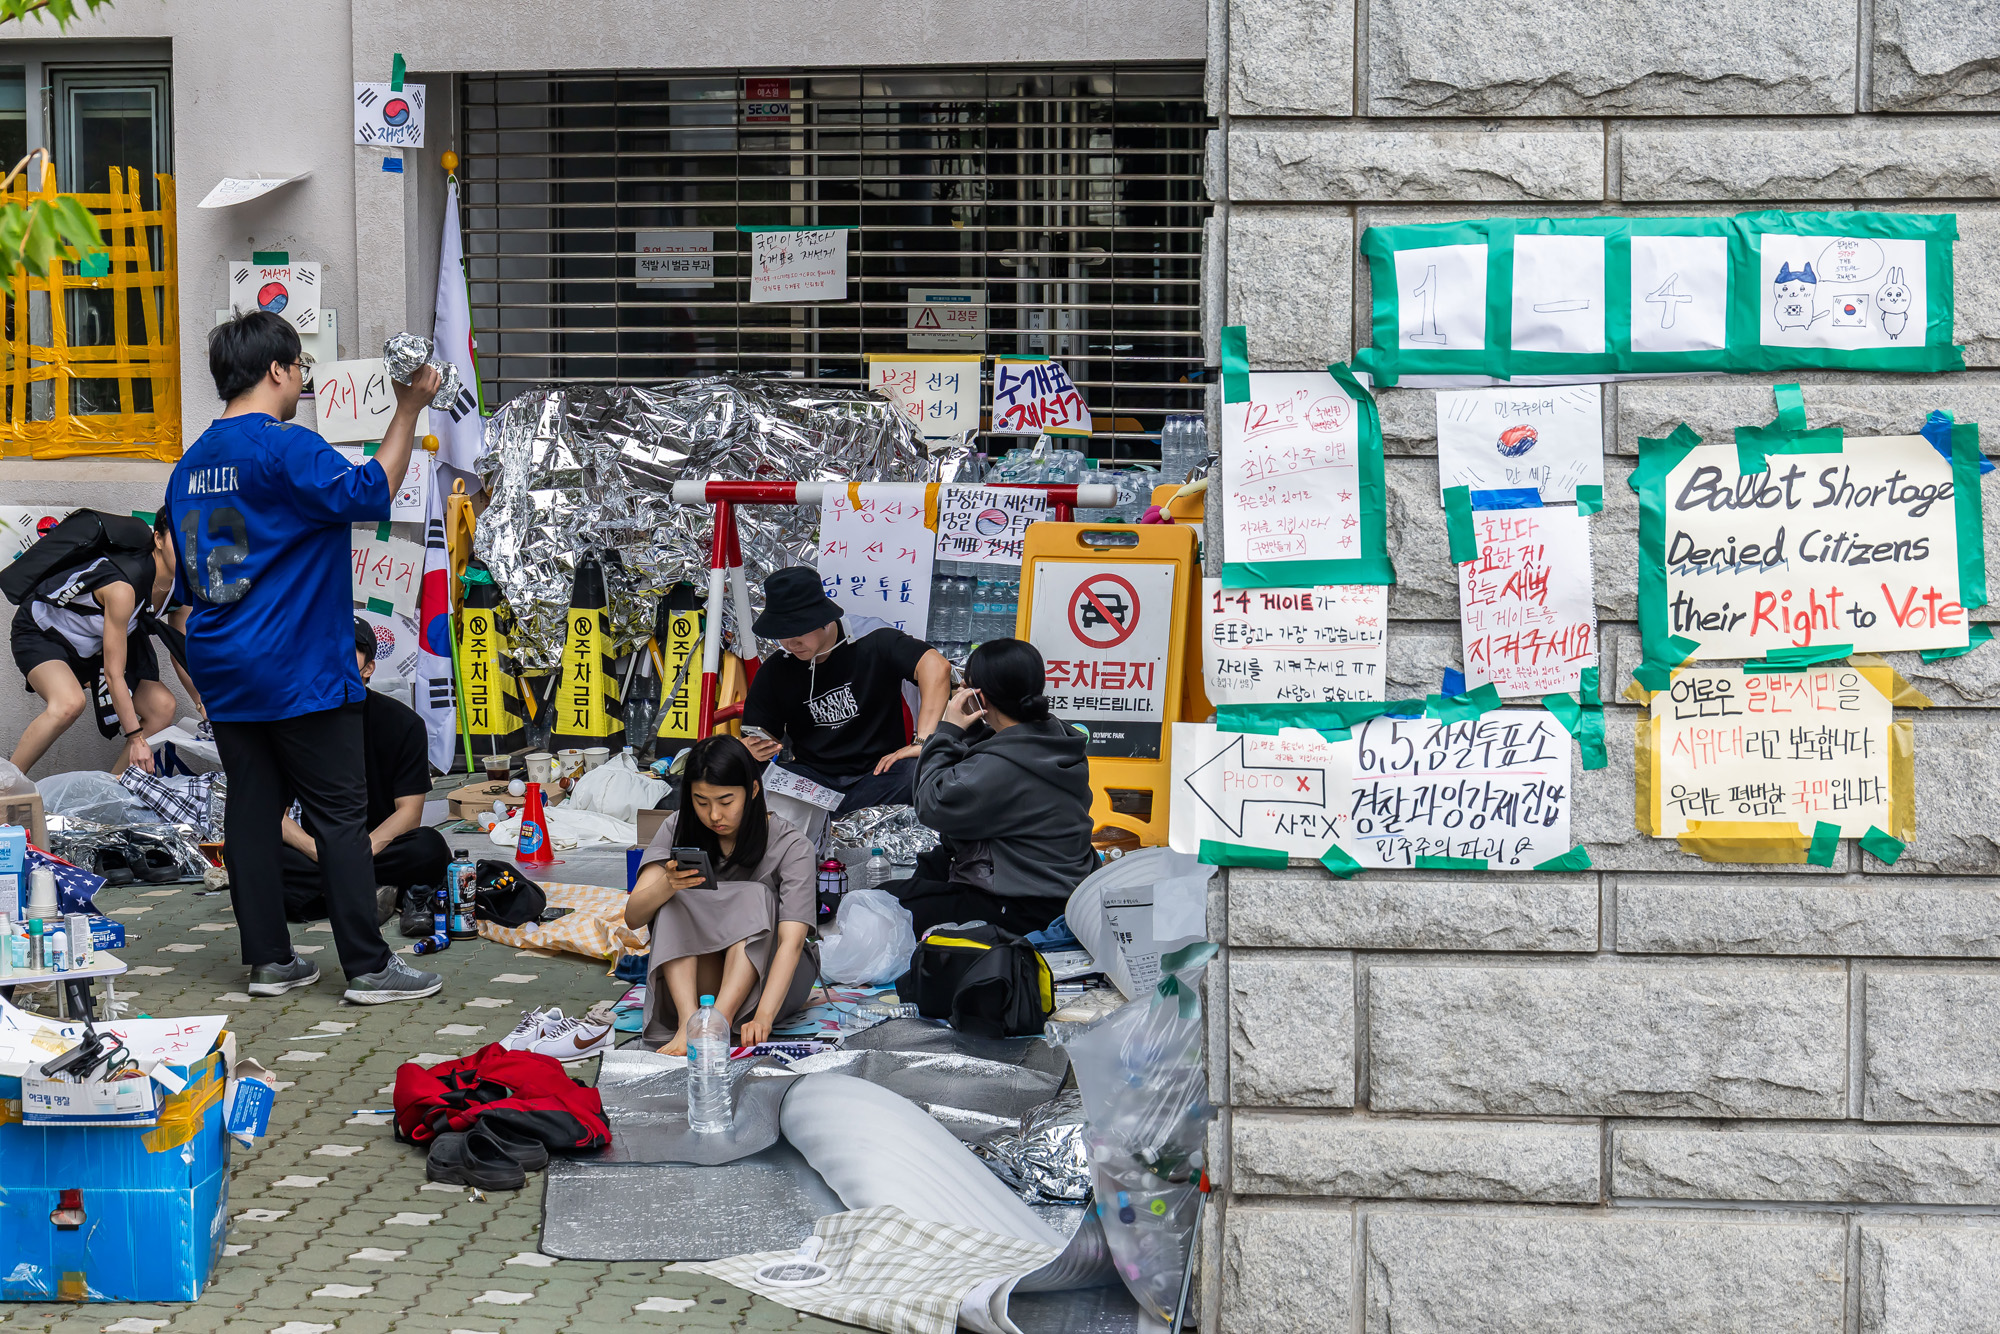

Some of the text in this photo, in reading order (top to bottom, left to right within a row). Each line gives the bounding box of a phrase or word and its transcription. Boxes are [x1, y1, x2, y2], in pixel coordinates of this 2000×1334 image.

[748, 103, 789, 115] SECOM
[260, 268, 291, 282] 재선거
[641, 260, 711, 271] 적발 시 벌금 부과
[947, 310, 978, 322] 고정문
[1409, 264, 1448, 345] 1
[1644, 272, 1693, 329] 4
[926, 372, 959, 395] 선거
[996, 363, 1074, 405] 수개표
[188, 466, 239, 495] WALLER
[1675, 461, 1955, 518] Ballot Shortage
[945, 488, 1047, 513] 부정선거 재선거
[943, 512, 972, 531] 당일
[180, 506, 251, 604] 12
[938, 533, 979, 553] 수개표
[1667, 525, 1930, 567] Denied Citizens
[1213, 590, 1251, 615] 1-4
[1466, 578, 1498, 607] 오늘
[1467, 605, 1558, 632] 빈 게이트를
[1669, 582, 1965, 648] their Right to Vote
[1279, 625, 1308, 644] 가장
[1314, 626, 1383, 645] 가깝습니다!
[1467, 622, 1593, 668] 지켜주세요
[470, 638, 489, 728] 주차금지
[1044, 660, 1155, 691] 주차금지
[1216, 658, 1264, 682] 자리를
[1273, 658, 1348, 678] 지켜주세요
[572, 639, 592, 730] 주차금지
[1277, 684, 1316, 702] 사람이
[1746, 672, 1861, 713] 일반시민을
[1073, 696, 1154, 712] 부탁드립니다.
[1672, 724, 1876, 769] 시위대라고 보도합니다.
[1223, 770, 1284, 793] PHOTO
[1667, 775, 1888, 816] 우리는 평범한 국민입니다.
[1376, 837, 1450, 864] 민주주의
[28, 1092, 70, 1106] 아크릴 명찰
